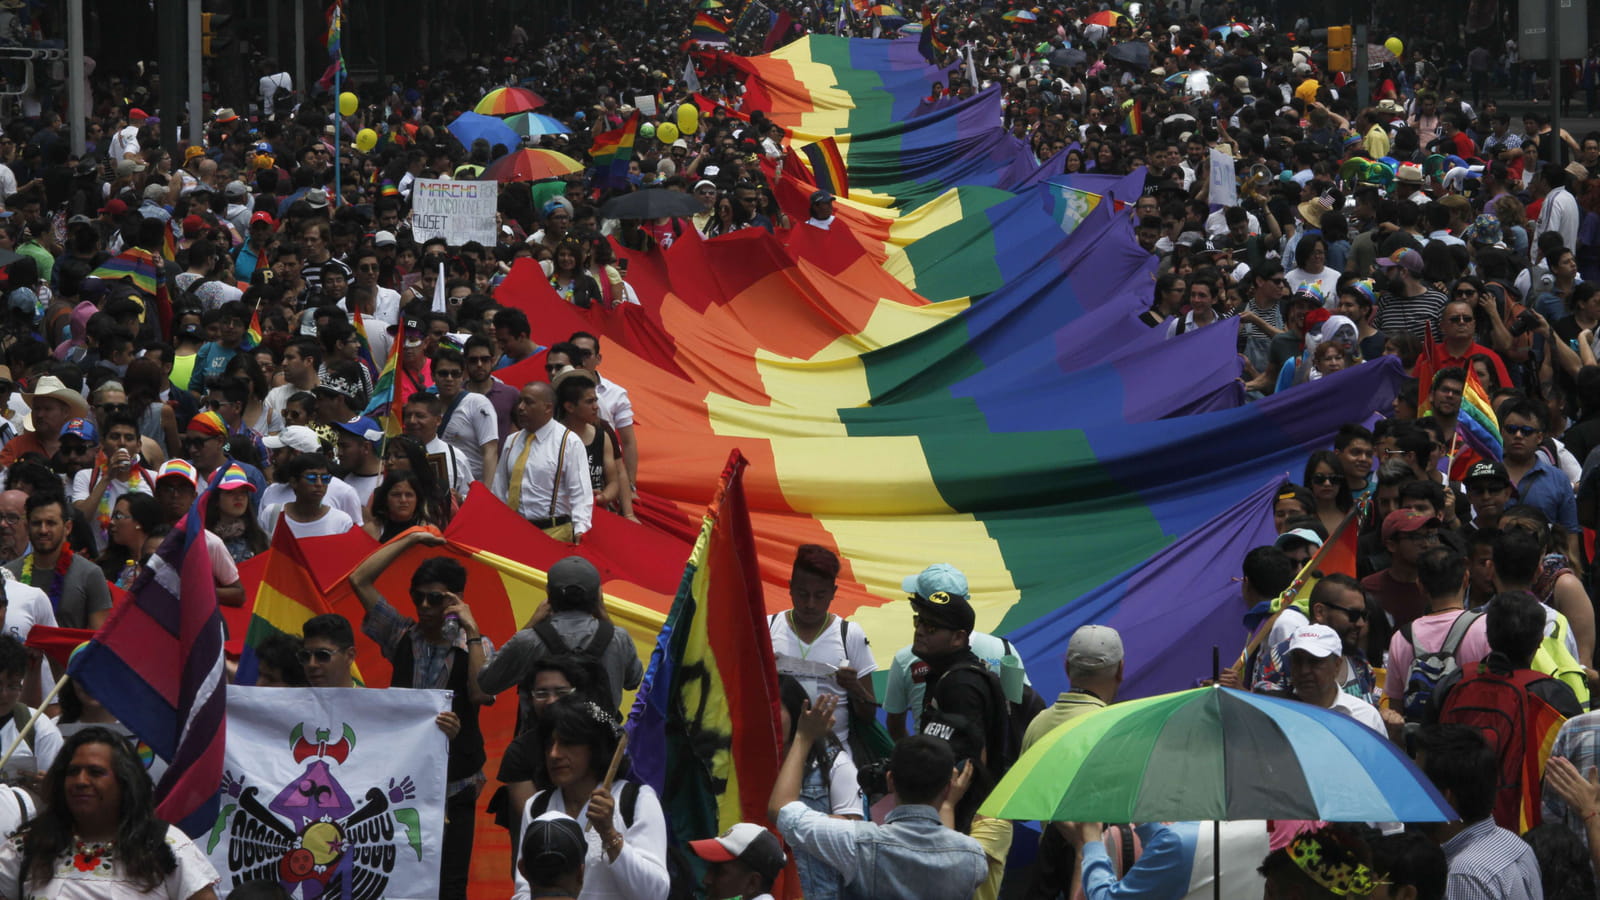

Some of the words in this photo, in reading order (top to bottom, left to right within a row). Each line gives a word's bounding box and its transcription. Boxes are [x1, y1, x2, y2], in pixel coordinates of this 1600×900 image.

[420, 182, 477, 198] MARCHO
[427, 198, 457, 214] MUNDO
[412, 214, 448, 230] CLOSET
[263, 270, 274, 284] P
